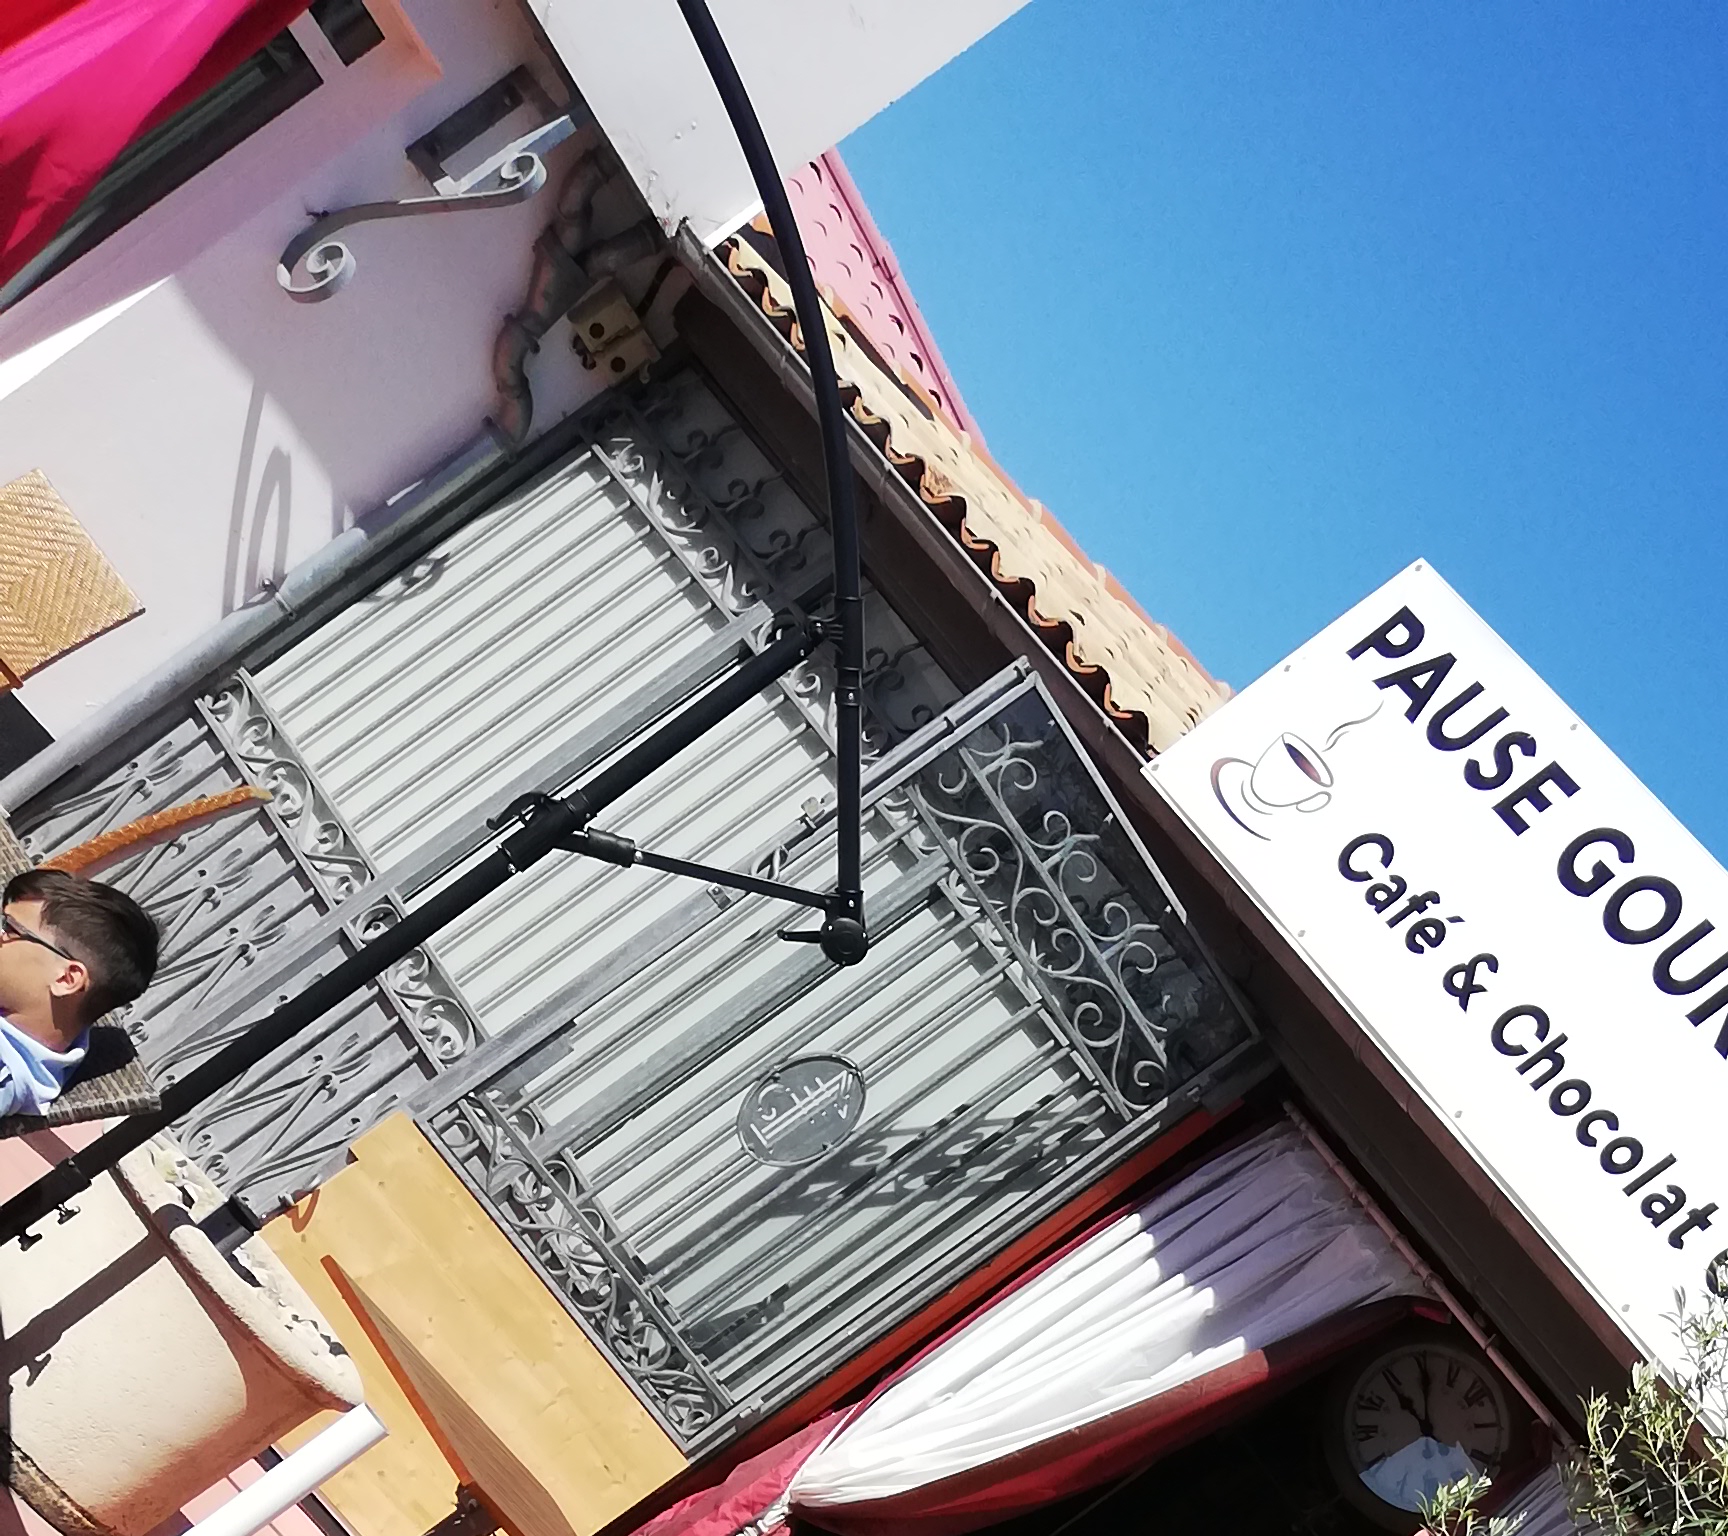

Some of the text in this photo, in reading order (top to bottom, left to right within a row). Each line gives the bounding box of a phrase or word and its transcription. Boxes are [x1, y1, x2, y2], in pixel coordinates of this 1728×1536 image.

[1346, 604, 1581, 837] PAUSE
[1337, 832, 1447, 955] Café
[1442, 953, 1499, 1013] &
[1490, 1003, 1720, 1250] Chocolat
